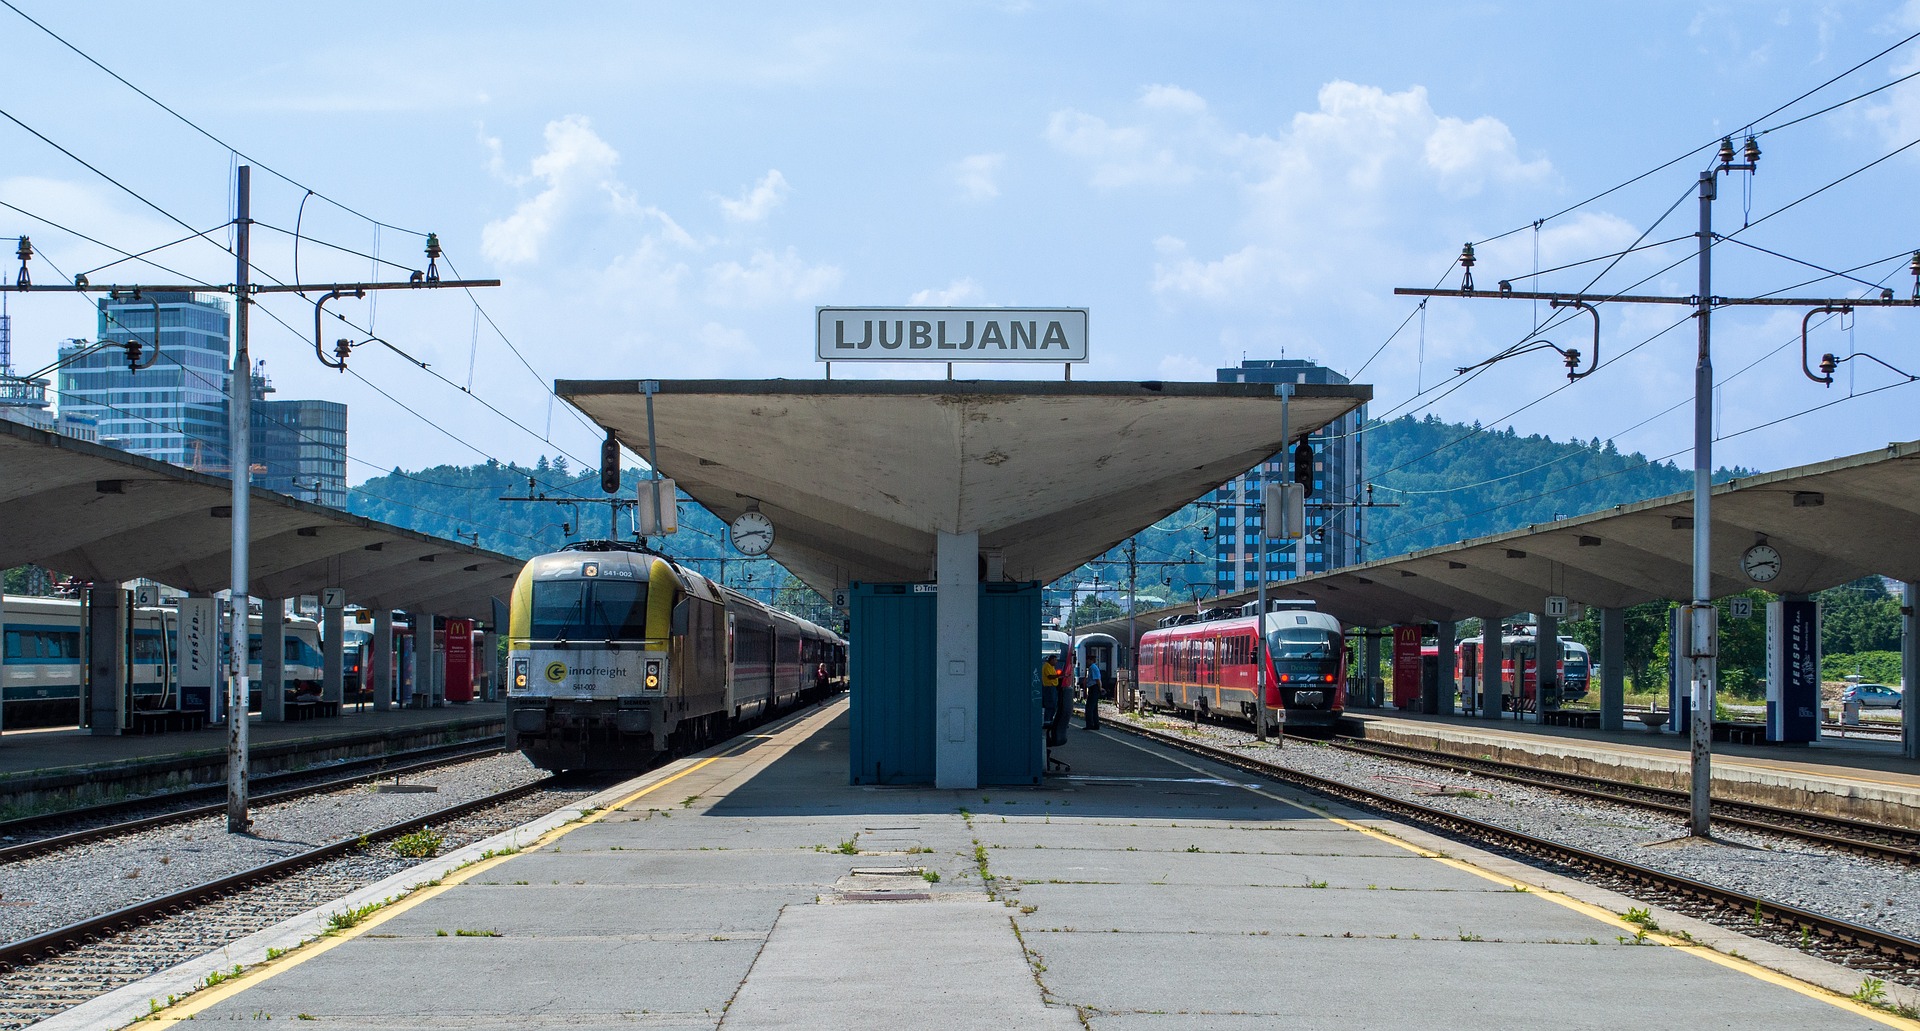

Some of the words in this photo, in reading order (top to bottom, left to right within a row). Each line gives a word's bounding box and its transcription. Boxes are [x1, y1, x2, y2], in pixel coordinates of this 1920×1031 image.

[835, 320, 1070, 350] LJUBLJANA
[140, 591, 148, 603] 6
[326, 593, 335, 605] 7
[836, 594, 845, 606] 8
[1551, 602, 1563, 613] 11
[1734, 603, 1748, 615] 12
[359, 612, 366, 621] A
[568, 666, 627, 679] innofreight
